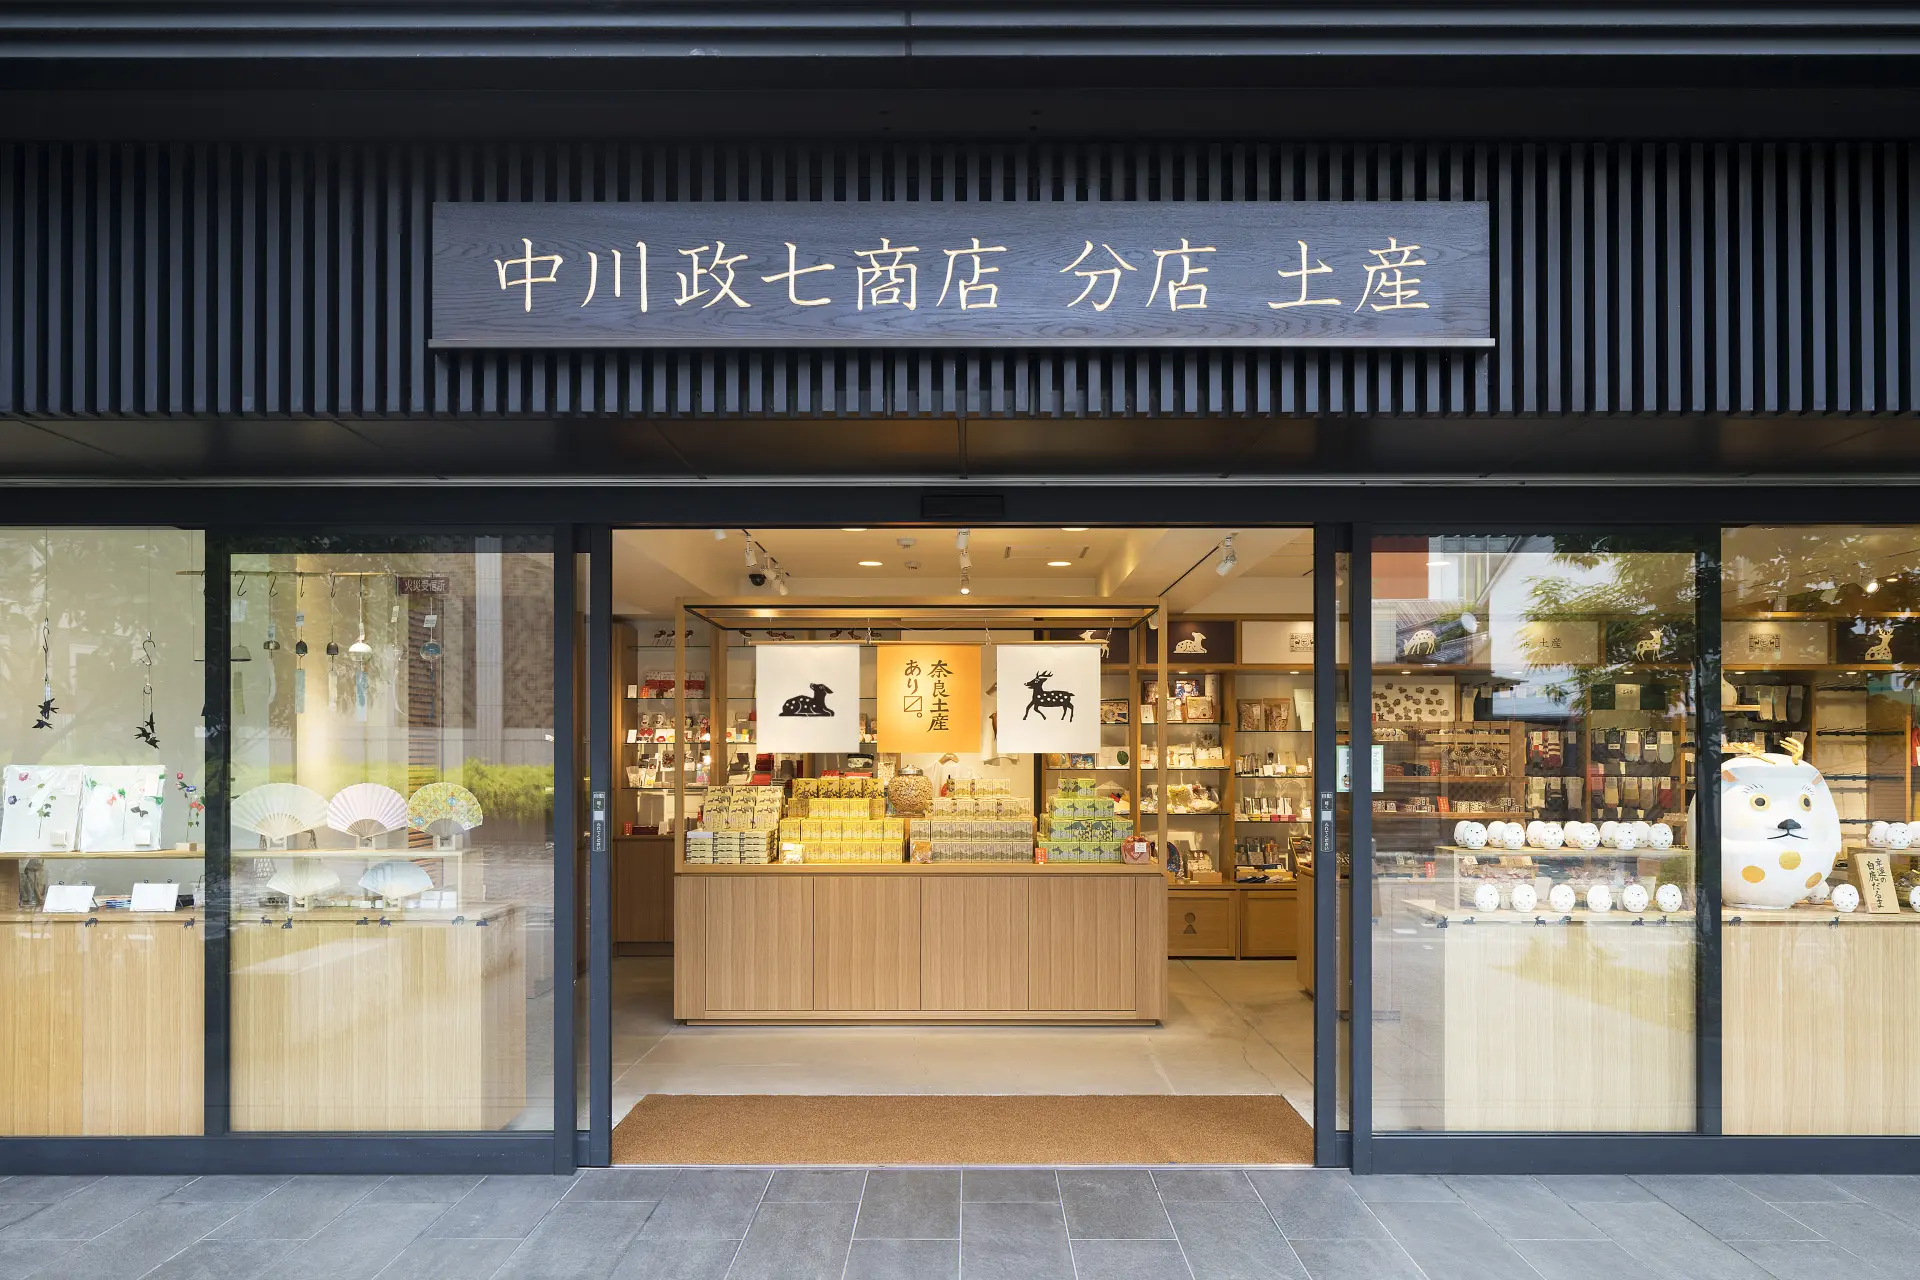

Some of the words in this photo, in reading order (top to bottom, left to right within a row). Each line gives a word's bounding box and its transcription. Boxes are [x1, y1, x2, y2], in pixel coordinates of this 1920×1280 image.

[494, 237, 1007, 313] 中川政七商店
[1059, 238, 1217, 312] 分店
[1267, 237, 1430, 313] 土産
[926, 659, 954, 733] 奈良土産
